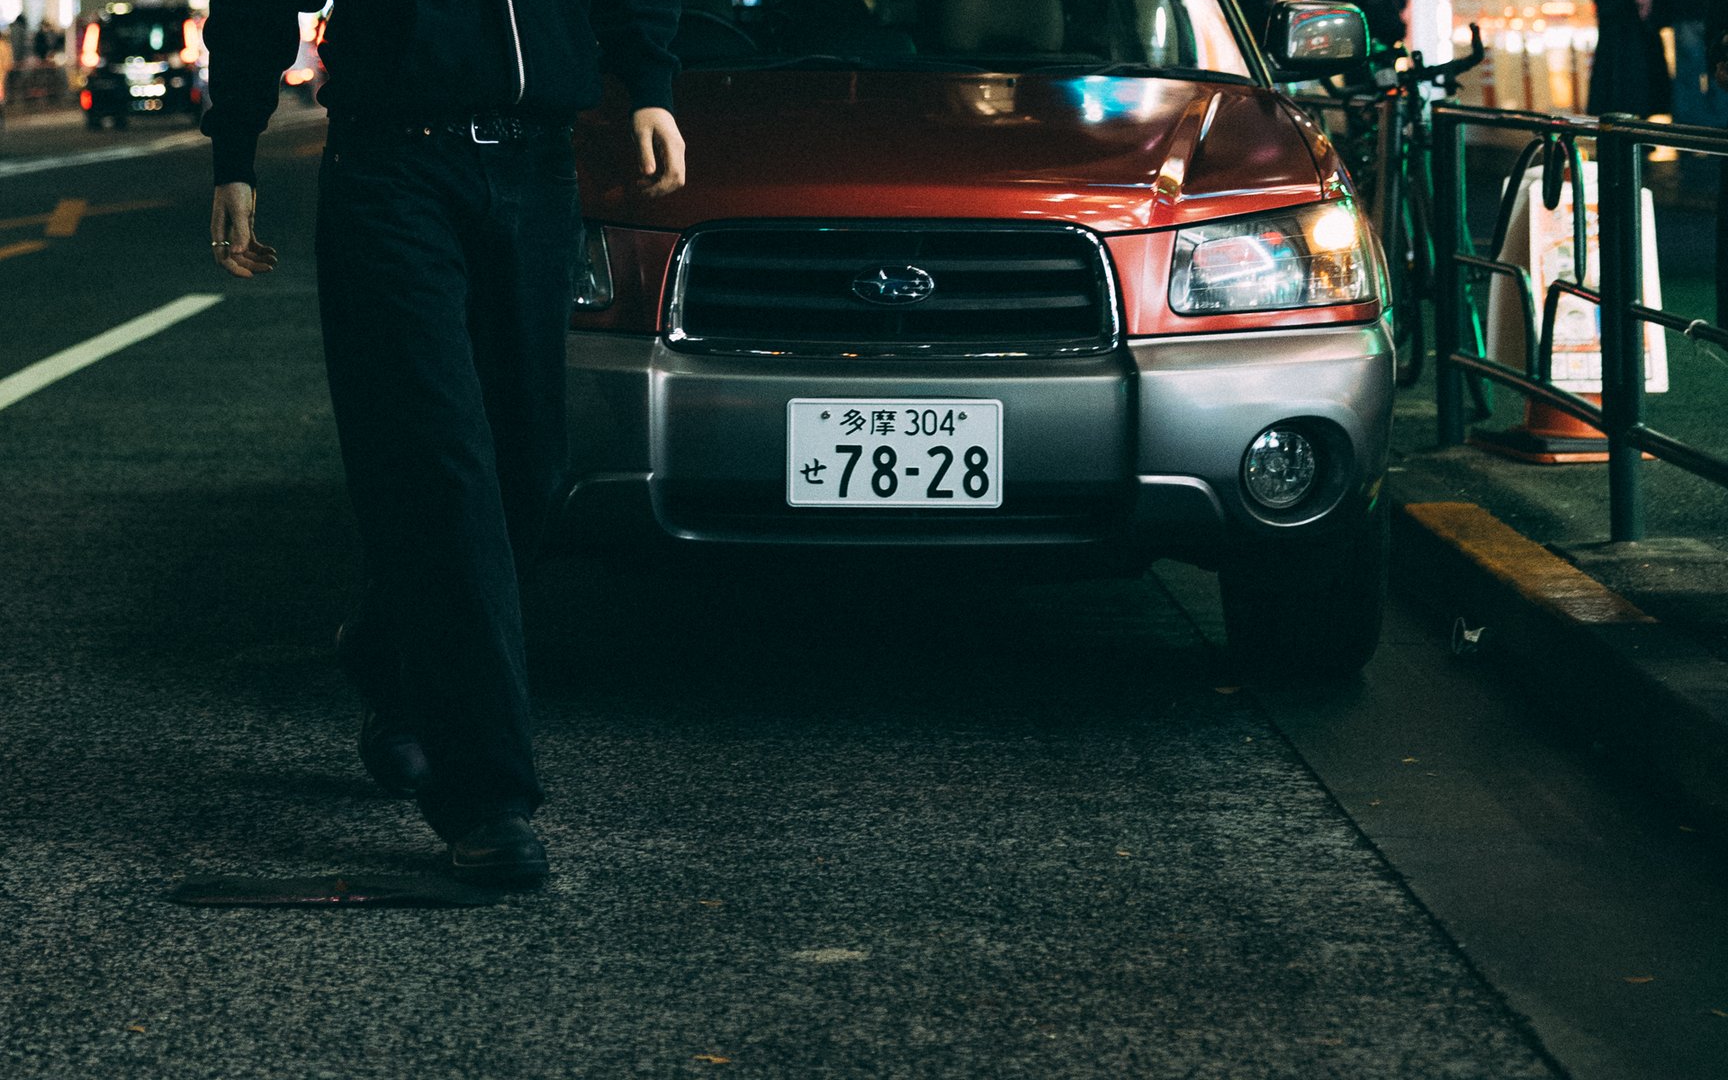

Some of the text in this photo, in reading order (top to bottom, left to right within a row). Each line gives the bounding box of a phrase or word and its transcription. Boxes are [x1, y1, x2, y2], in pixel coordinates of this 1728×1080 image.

[839, 408, 956, 437] 多摩 304
[799, 444, 990, 499] せ 78-28
